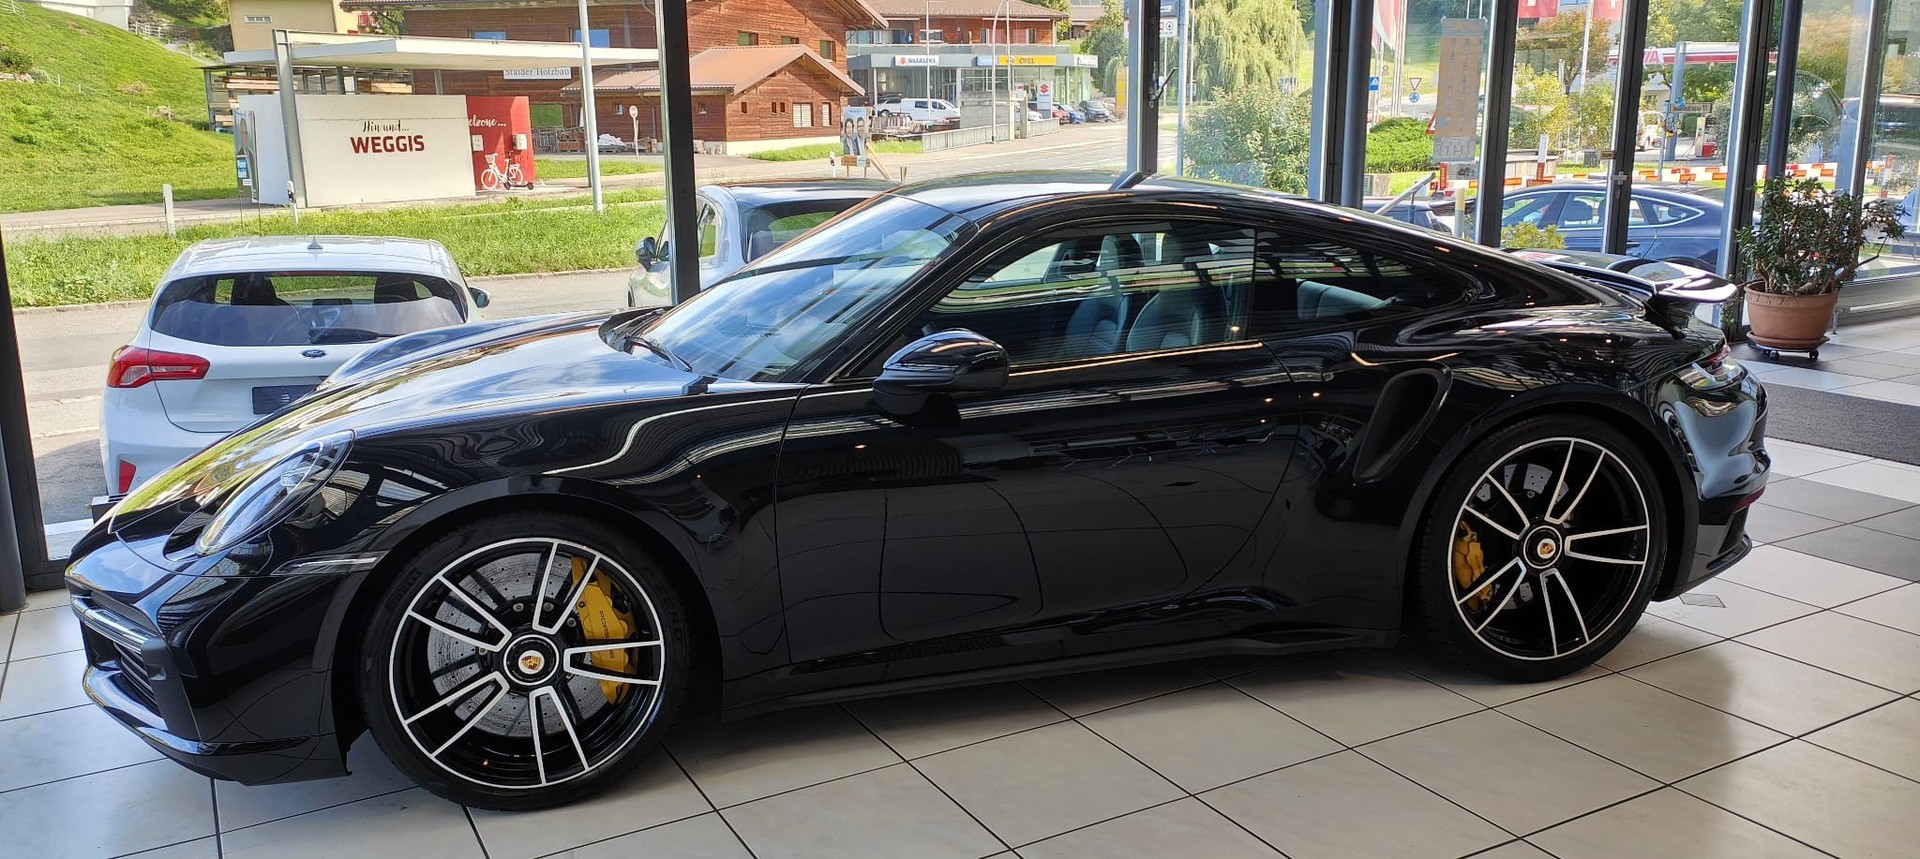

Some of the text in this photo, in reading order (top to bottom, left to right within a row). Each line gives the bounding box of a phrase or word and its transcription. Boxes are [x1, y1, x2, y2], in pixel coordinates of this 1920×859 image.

[536, 67, 570, 76] Holzbau
[363, 120, 380, 132] Hin
[350, 134, 425, 154] WEGGIS
